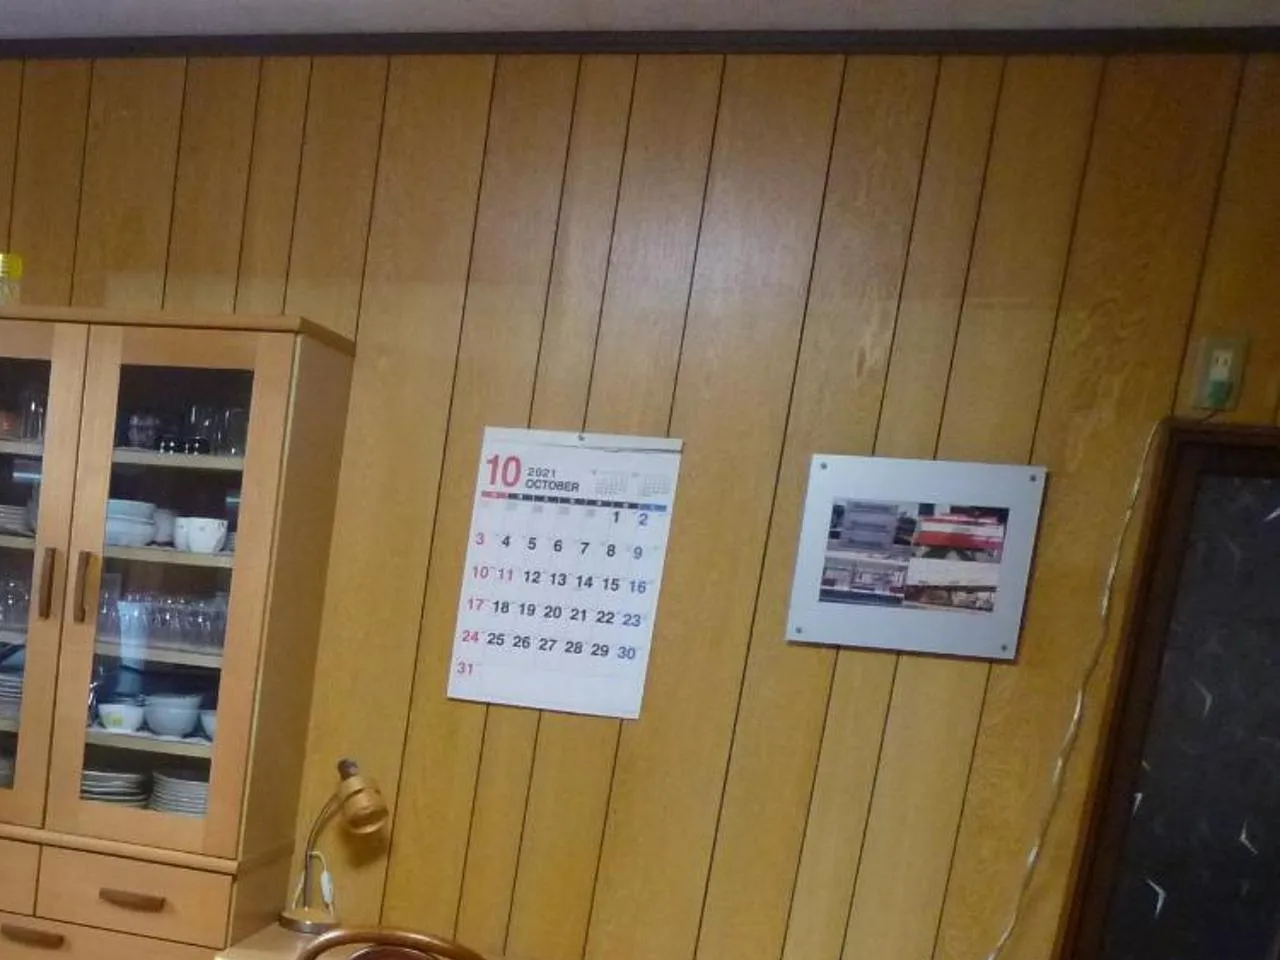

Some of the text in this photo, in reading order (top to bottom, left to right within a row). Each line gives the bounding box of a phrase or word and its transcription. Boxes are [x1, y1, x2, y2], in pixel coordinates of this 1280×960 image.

[486, 453, 522, 488] 10
[527, 466, 556, 478] 2021
[525, 479, 580, 492] OCTOBER
[638, 512, 648, 526] 2
[475, 533, 643, 560] 3 4 5 6 7 8 9
[472, 566, 646, 594] 10 11 12 13 14 15 16
[468, 598, 641, 627] 17 18 19 20 21 22 23
[462, 629, 636, 660] 24 25 26 27 28 29 30
[457, 661, 473, 675] 31
